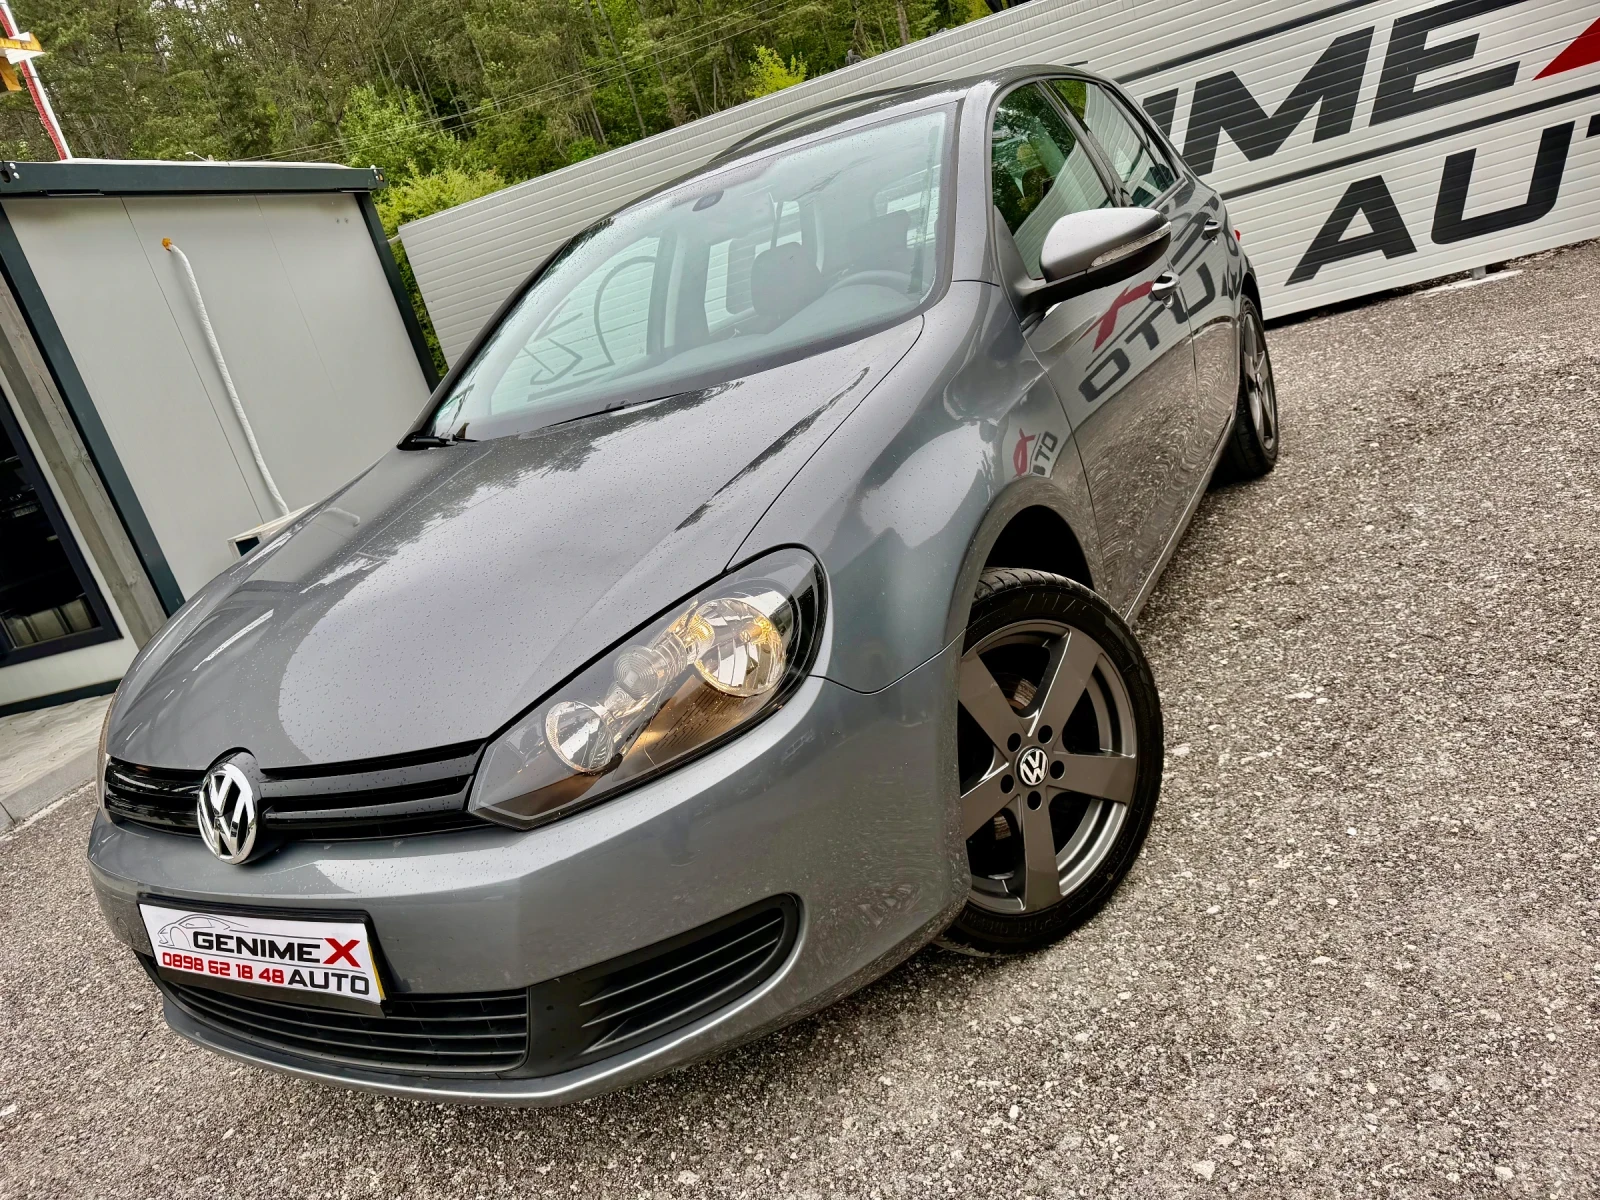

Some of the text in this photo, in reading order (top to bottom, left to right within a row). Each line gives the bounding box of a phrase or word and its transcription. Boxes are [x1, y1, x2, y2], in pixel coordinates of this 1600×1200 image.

[1284, 114, 1600, 286] AU
[193, 930, 361, 968] GENIMEX
[162, 952, 285, 985] 0898 62 18 48
[288, 969, 369, 996] AUTO
